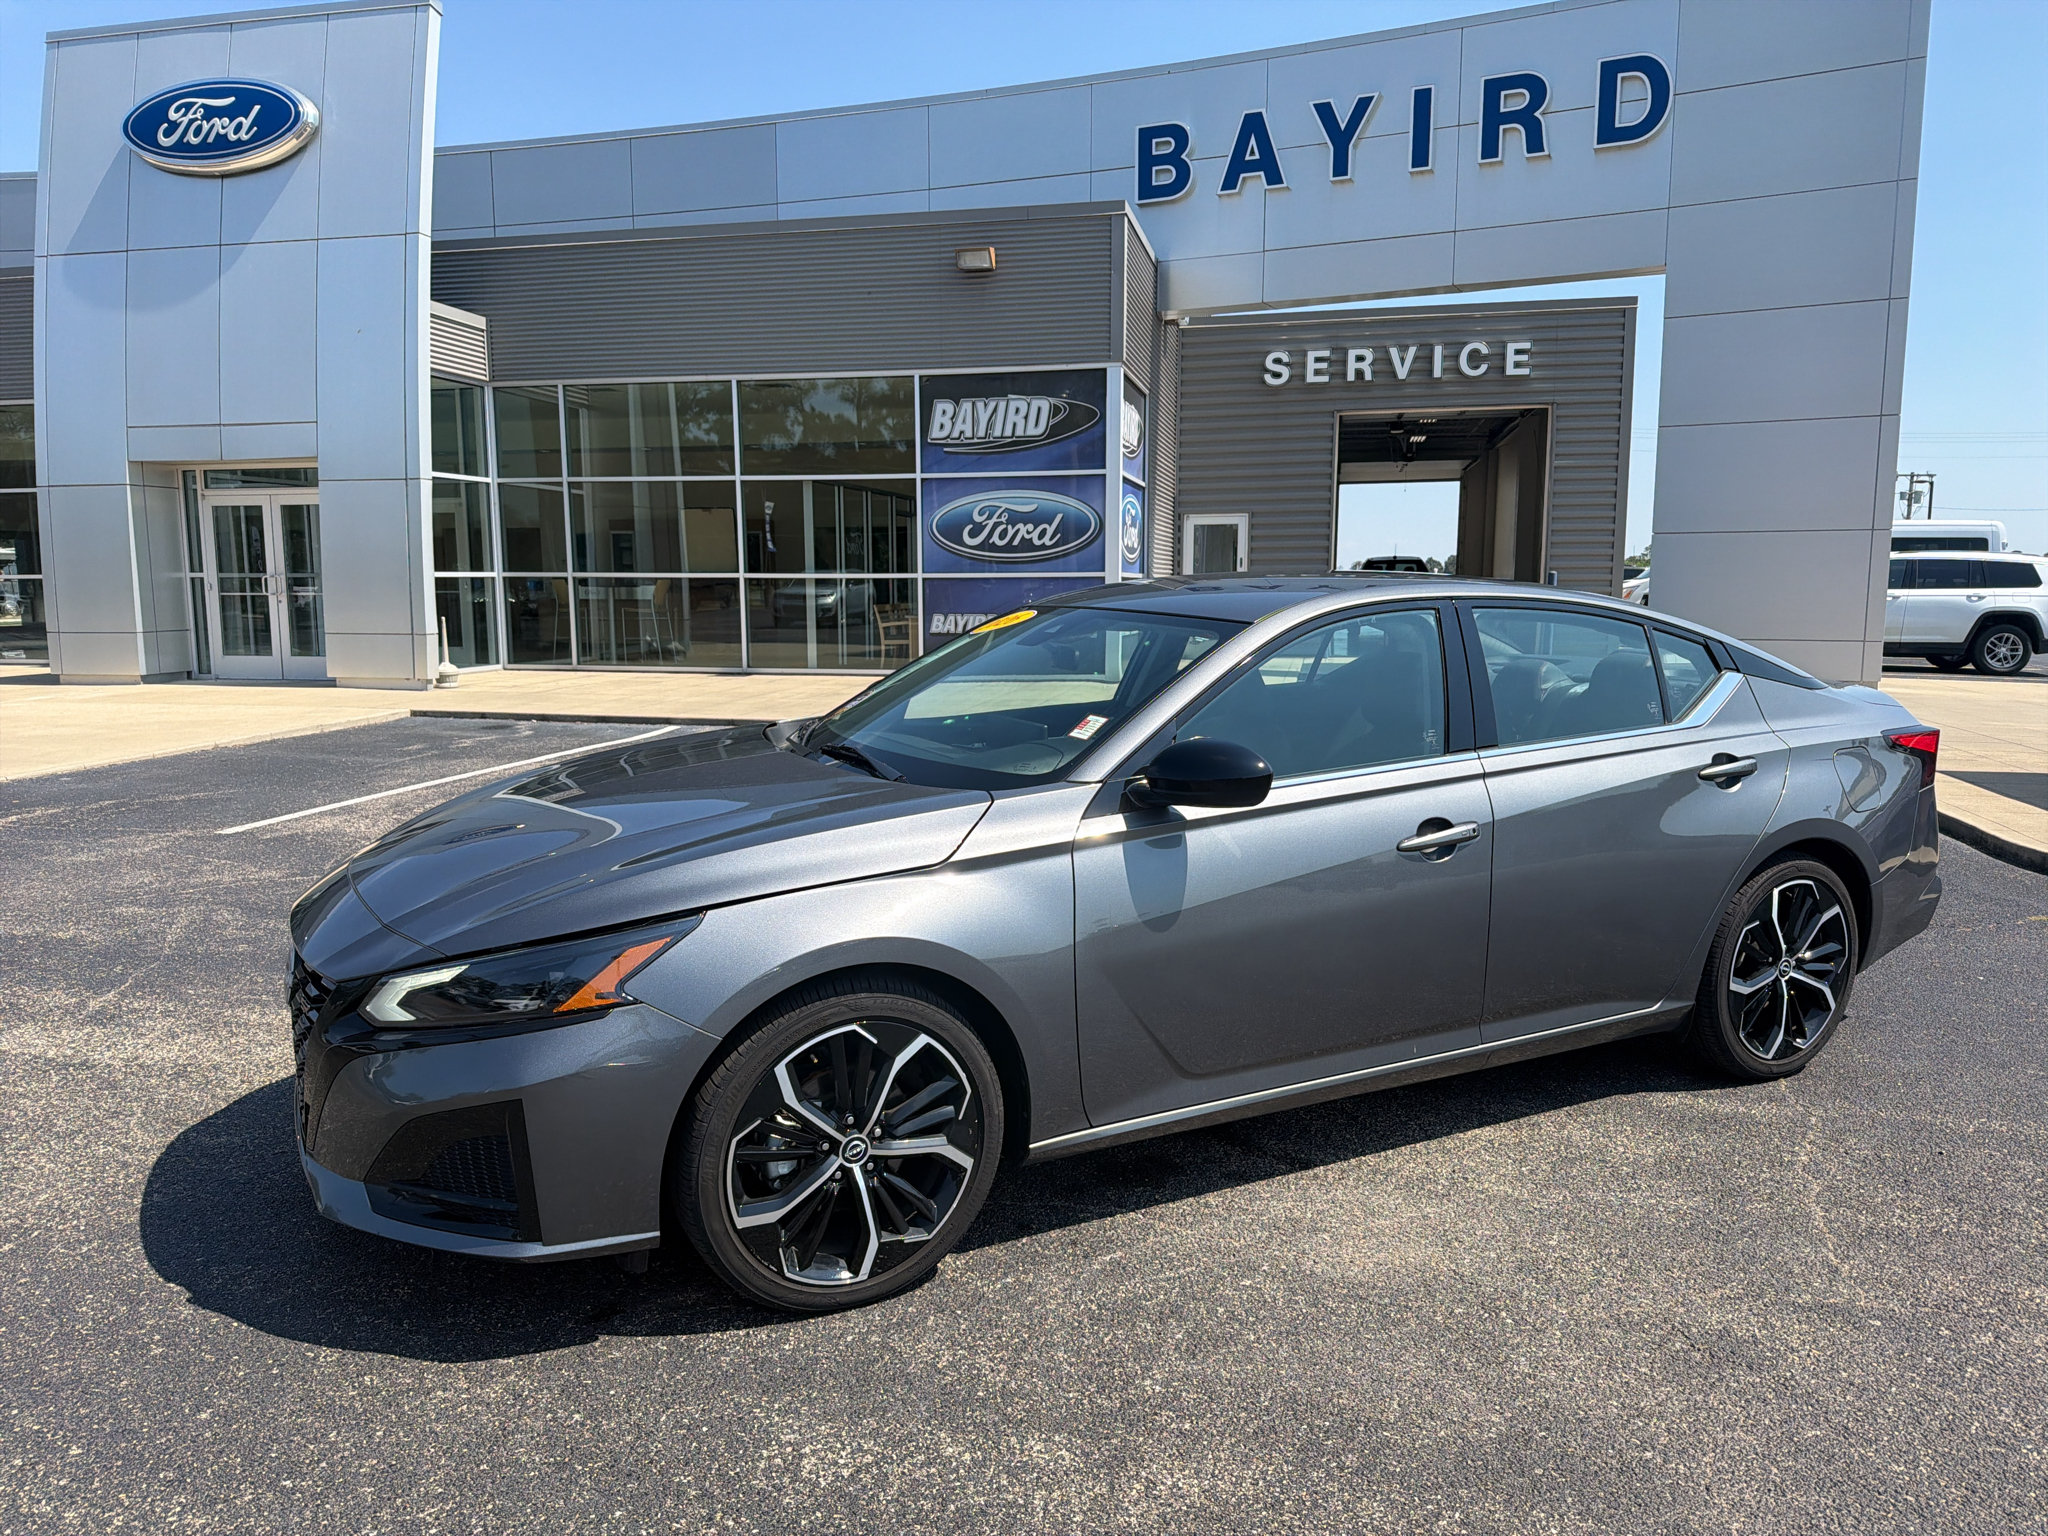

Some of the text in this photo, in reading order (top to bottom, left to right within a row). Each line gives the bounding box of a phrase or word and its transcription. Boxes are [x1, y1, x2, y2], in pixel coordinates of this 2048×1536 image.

[157, 96, 261, 147] Ford
[1135, 52, 1673, 205] BAYIRD
[1263, 341, 1533, 386] SERVICE
[928, 396, 1053, 443] BAYIRD
[963, 502, 1064, 546] Ford
